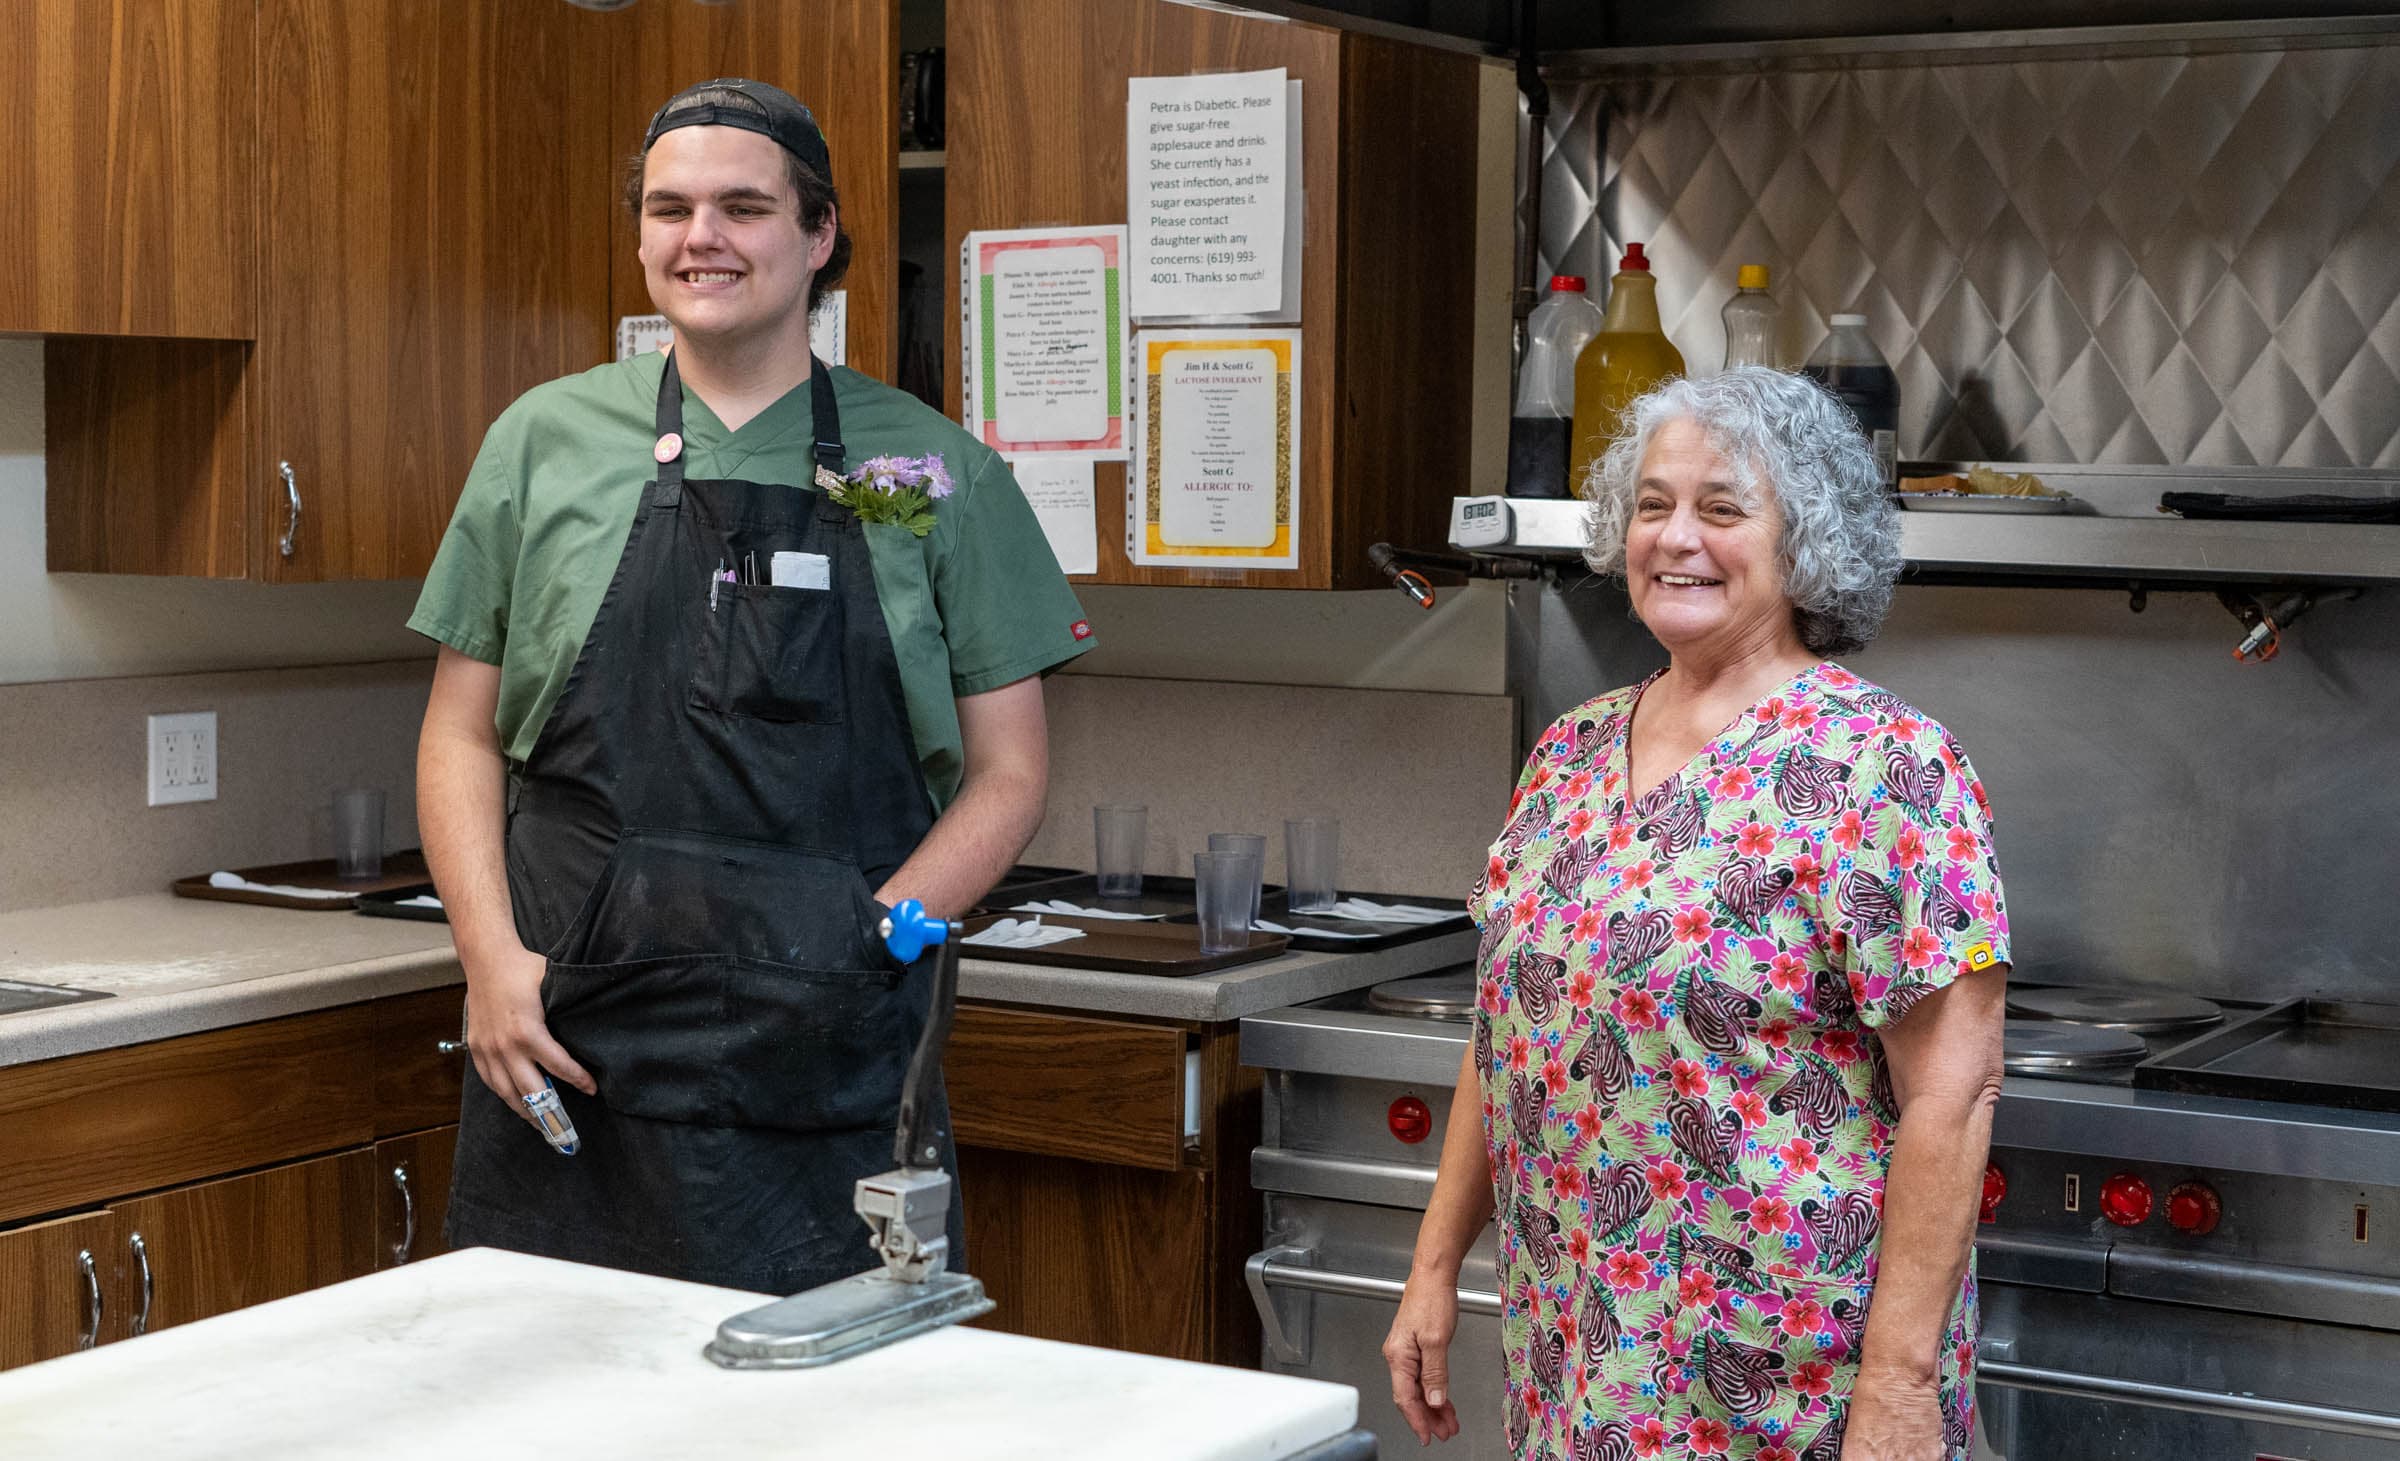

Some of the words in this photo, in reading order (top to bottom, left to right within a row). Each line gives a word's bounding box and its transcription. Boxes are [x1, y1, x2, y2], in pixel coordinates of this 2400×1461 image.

[1150, 101, 1180, 112] Petra
[1183, 100, 1192, 112] is
[1194, 99, 1240, 111] Diabetic.
[1243, 97, 1272, 108] Please
[1150, 122, 1173, 134] give
[1176, 118, 1230, 133] sugar-free
[1150, 140, 1212, 153] applesauce
[1214, 137, 1234, 148] and
[1237, 135, 1267, 147] drinks.
[1150, 159, 1171, 170] She
[1174, 157, 1222, 170] currently
[1225, 155, 1243, 167] has
[1245, 157, 1251, 166] a
[1150, 180, 1180, 191] yeast
[1183, 176, 1233, 188] infection,
[1235, 173, 1254, 186] and
[1255, 173, 1270, 184] the
[1150, 198, 1181, 210] sugar
[1183, 195, 1246, 208] exasperates
[1247, 193, 1257, 205] it.
[1151, 216, 1186, 227] Please
[1189, 215, 1229, 226] contact
[1150, 235, 1201, 248] daughter
[1203, 233, 1227, 245] with
[1230, 234, 1248, 247] any
[1150, 254, 1204, 265] concerns:
[1206, 251, 1235, 266] (619)
[1150, 272, 1182, 284] 4001.
[1185, 271, 1222, 283] Thanks
[1225, 272, 1237, 282] so
[1239, 269, 1265, 281] much!
[1184, 361, 1200, 371] Jim
[1202, 361, 1210, 371] H
[1211, 361, 1220, 371] &
[1222, 361, 1244, 371] Scott
[1245, 360, 1254, 370] G
[1175, 376, 1210, 384] LACTOSE
[1212, 375, 1263, 384] INTOLERANT
[1202, 467, 1224, 476] Scott
[1225, 467, 1234, 476] G
[1183, 481, 1233, 492] ALLERGIC
[1237, 481, 1254, 492] TO:
